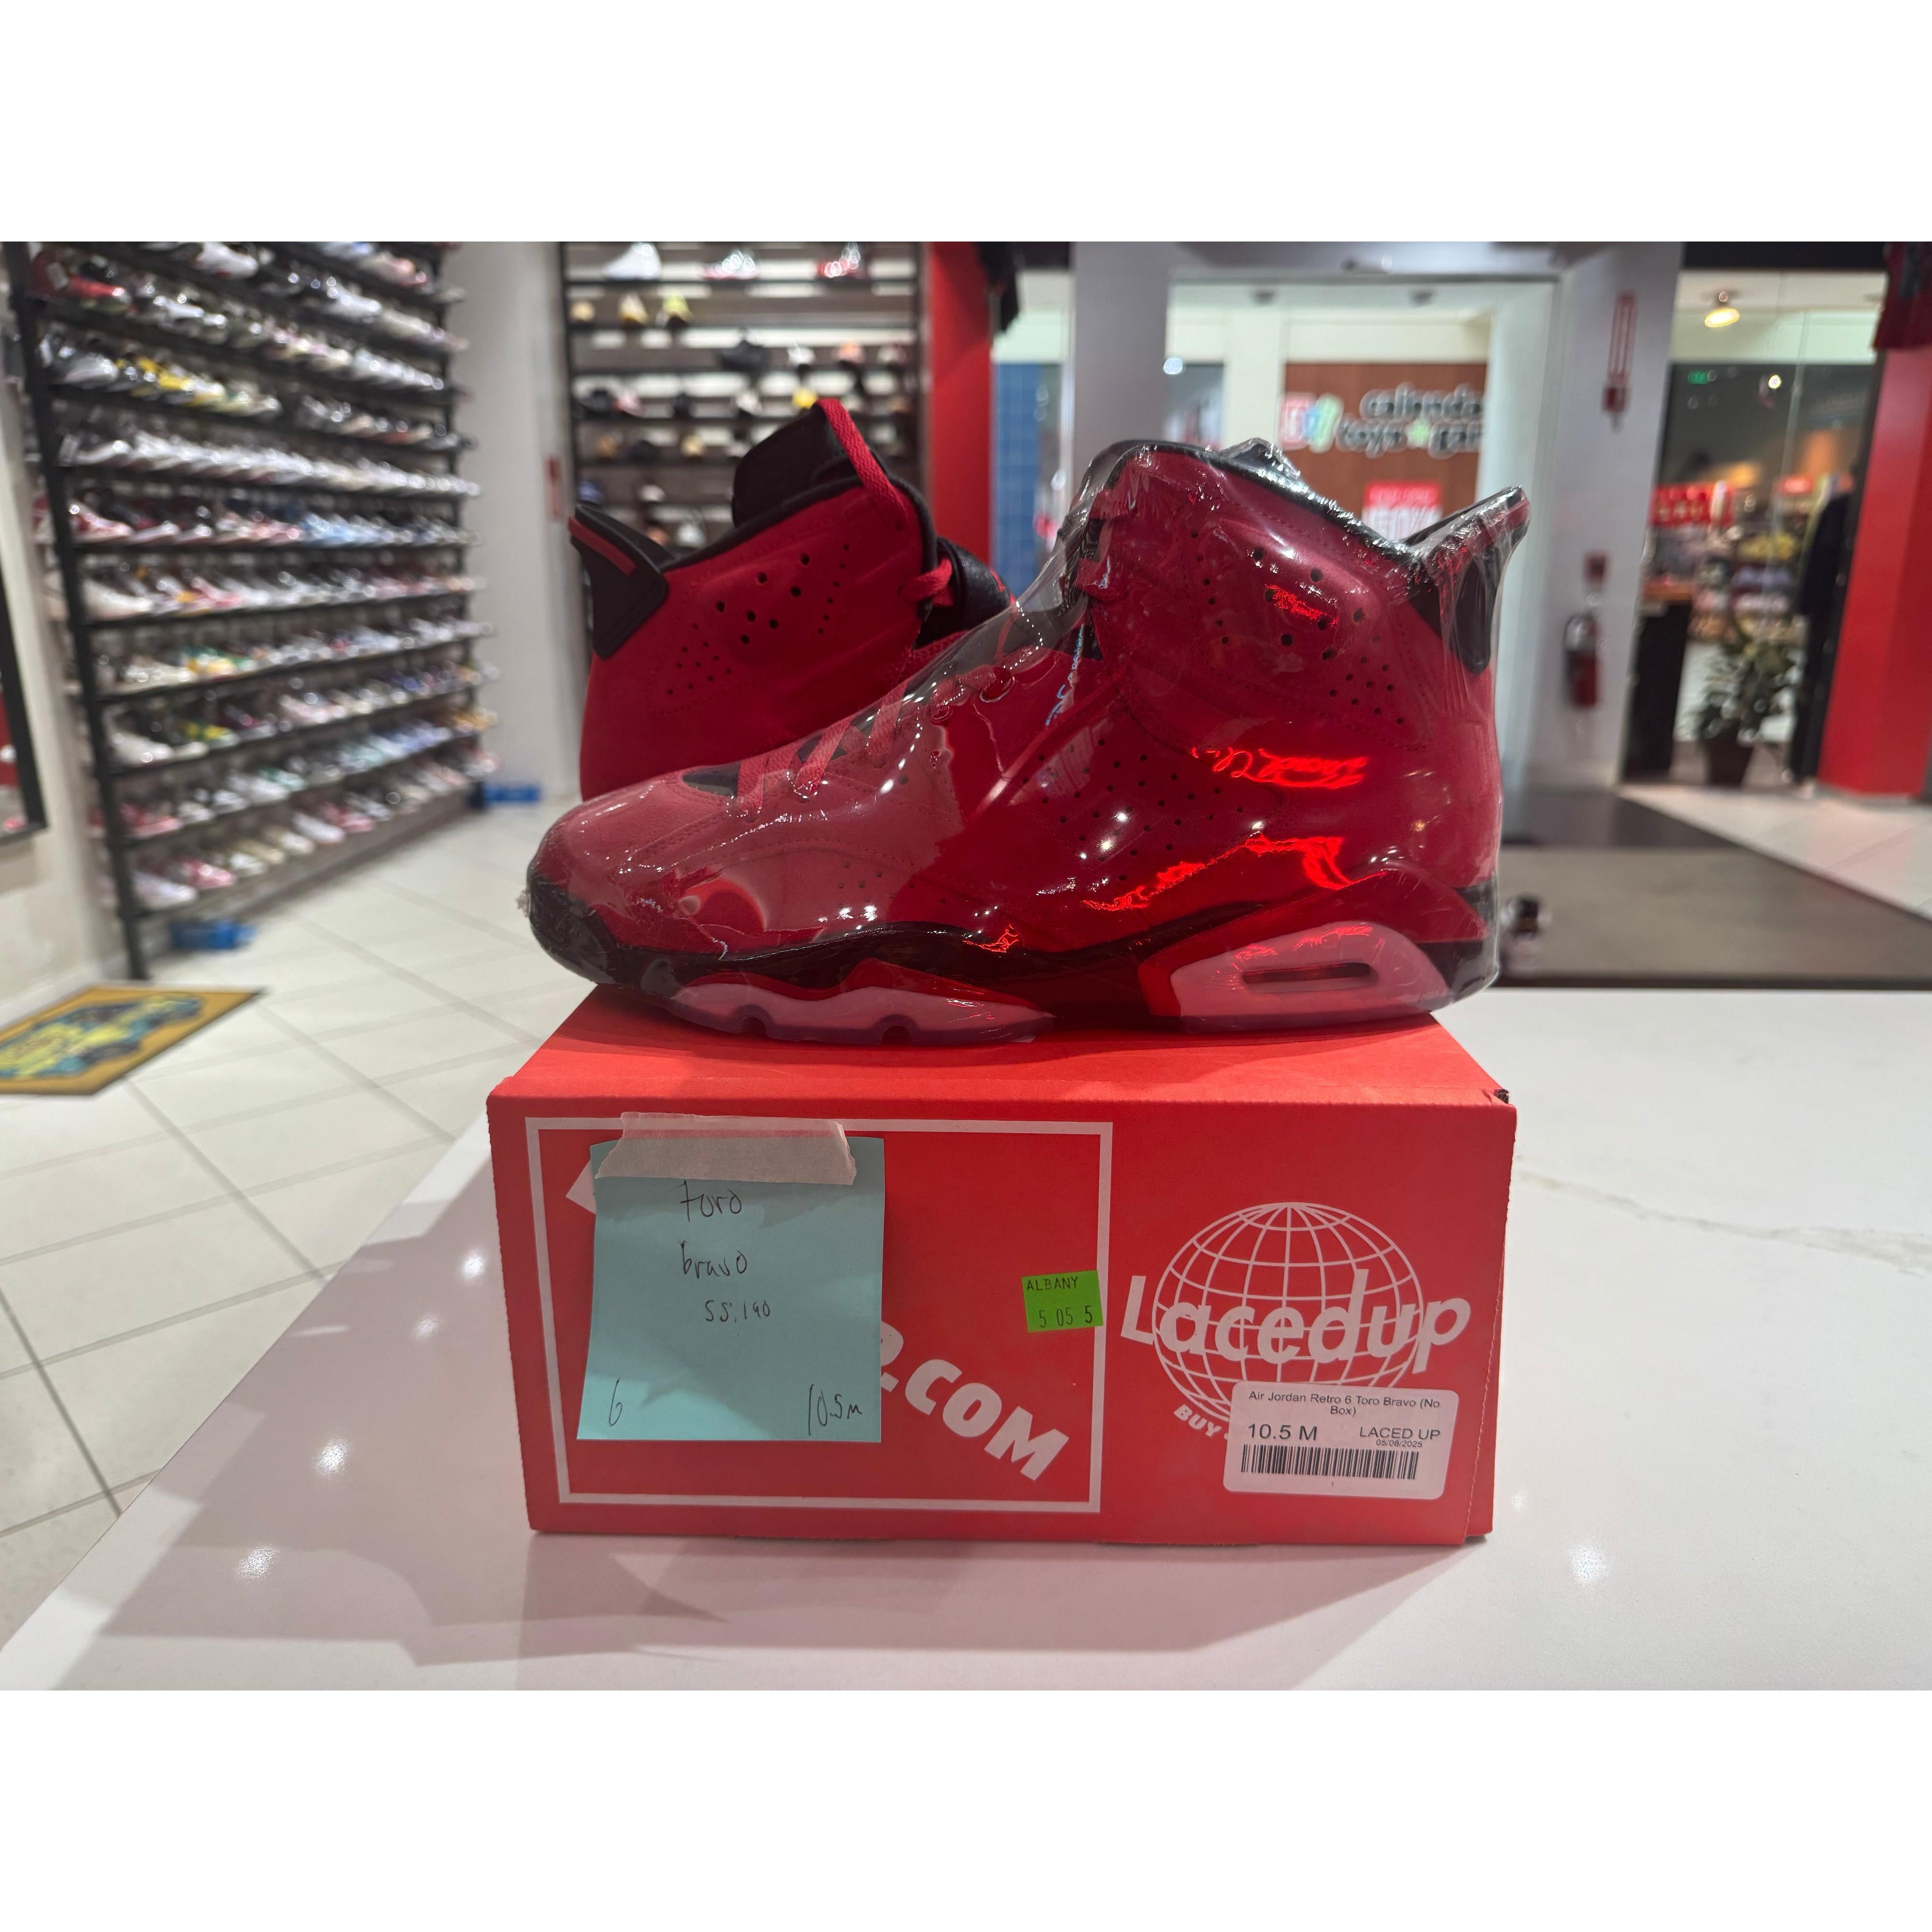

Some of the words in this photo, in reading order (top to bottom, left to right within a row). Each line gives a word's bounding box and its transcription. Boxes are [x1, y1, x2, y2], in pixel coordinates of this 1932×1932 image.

[1026, 1276, 1079, 1292] ALBANY
[1120, 1268, 1471, 1375] Lacedup
[609, 1378, 623, 1426] 6
[1249, 1391, 1264, 1400] Air
[1268, 1392, 1306, 1402] Jordan
[1310, 1393, 1341, 1404] Retro
[1345, 1395, 1351, 1404] 6
[1356, 1395, 1379, 1405] Toro
[1383, 1396, 1416, 1407] Bravo
[1420, 1398, 1440, 1409] (No
[1330, 1406, 1356, 1416] Box)
[1173, 1404, 1222, 1437] BUY
[1248, 1423, 1291, 1440] 10.5
[1299, 1425, 1318, 1441] M
[1360, 1426, 1413, 1439] LACED
[1419, 1429, 1440, 1440] UP
[1376, 1438, 1422, 1448] 05/08/2025
